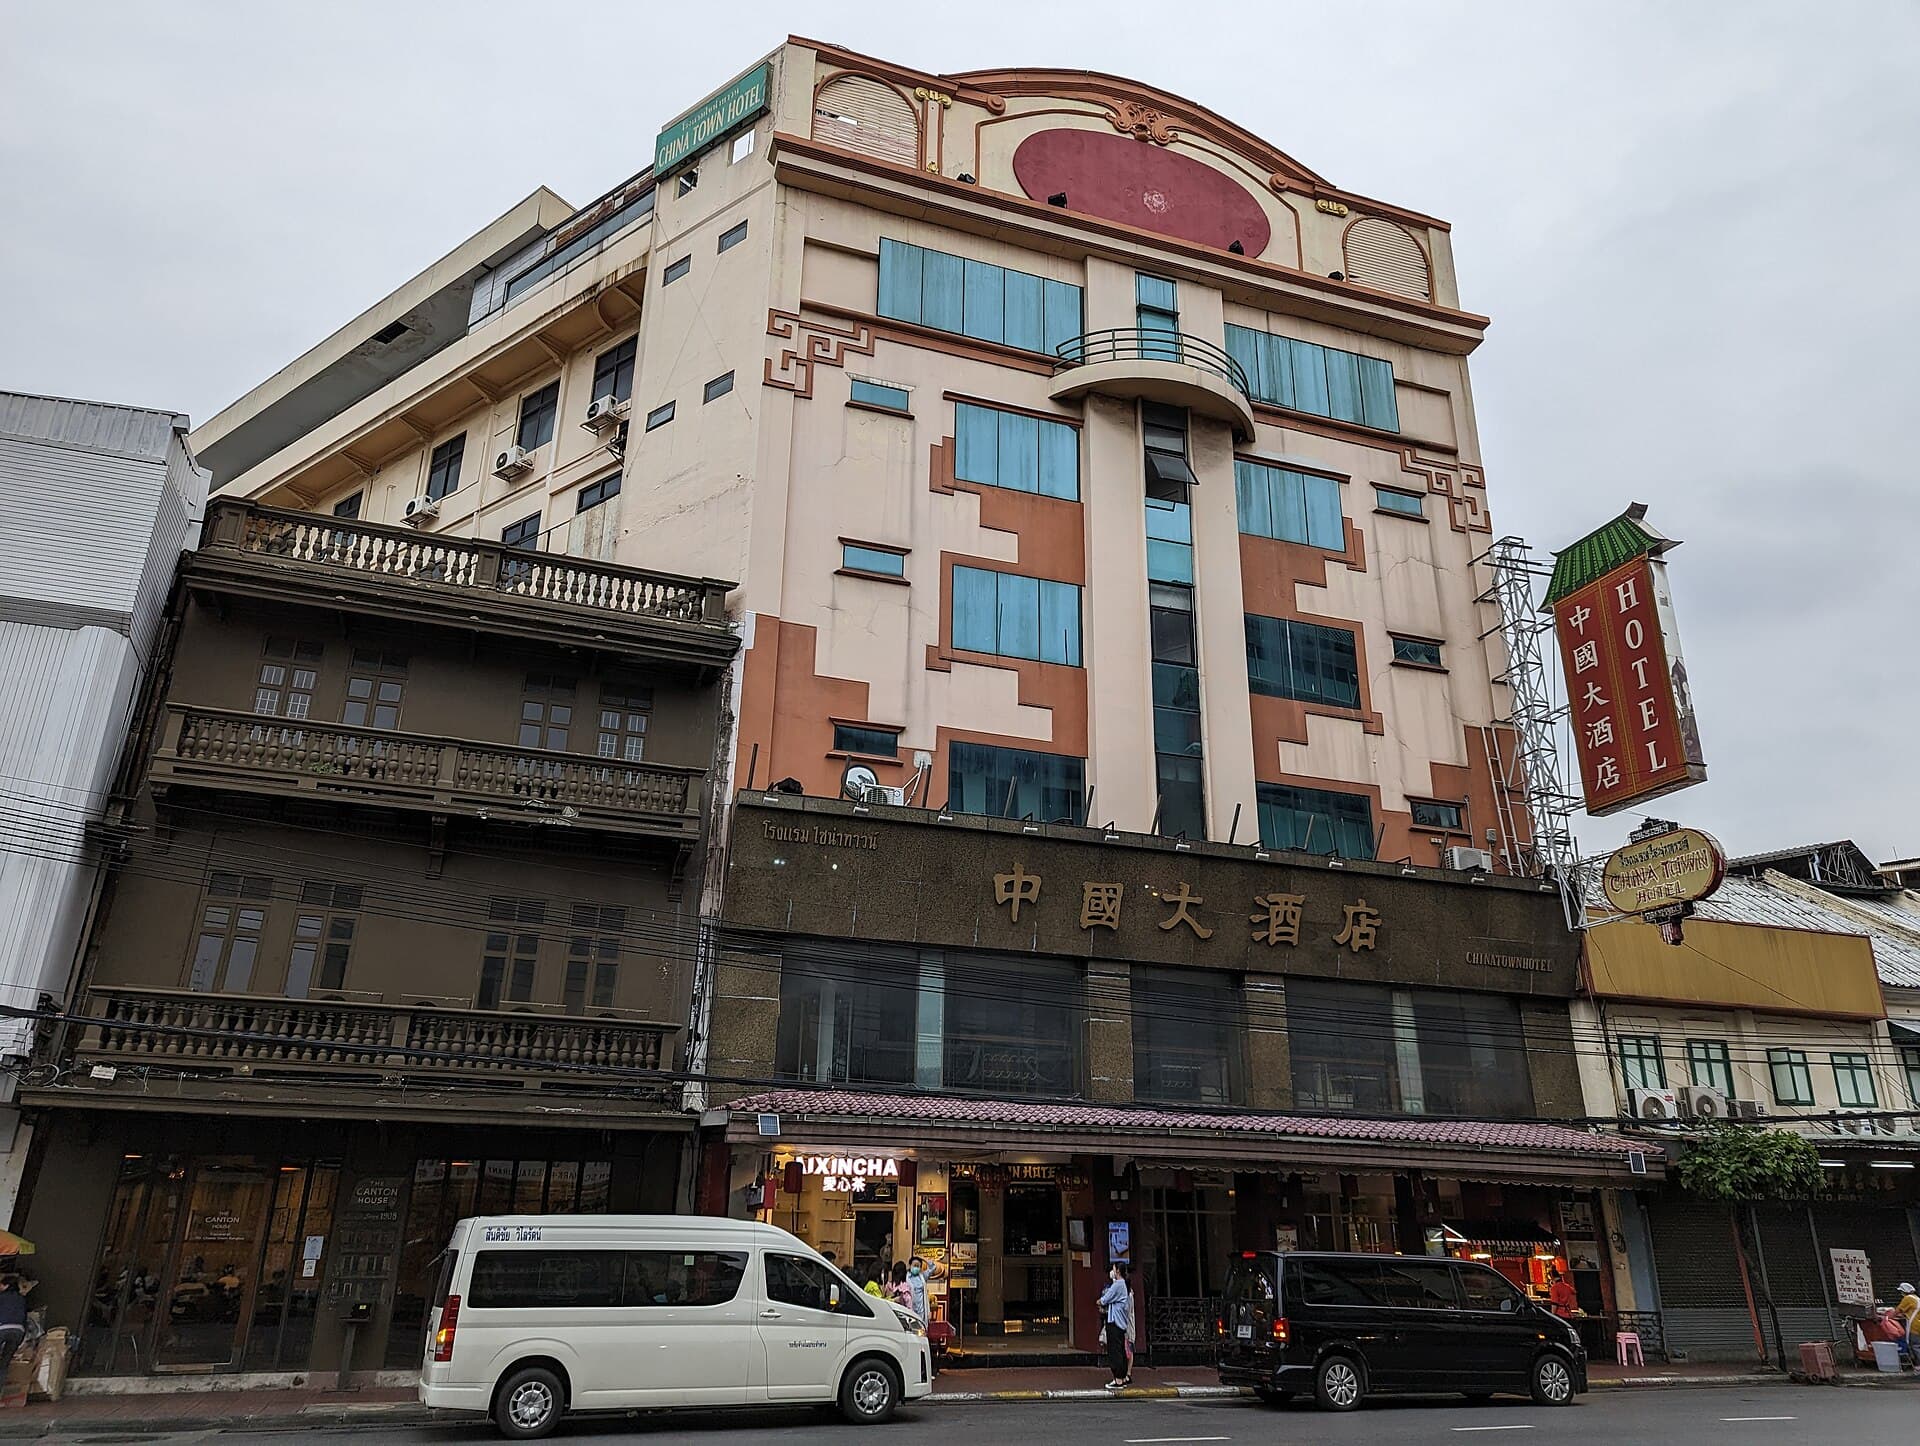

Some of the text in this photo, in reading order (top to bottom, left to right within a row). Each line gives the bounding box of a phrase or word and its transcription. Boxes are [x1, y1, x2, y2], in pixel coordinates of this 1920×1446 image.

[658, 131, 690, 169] CHINA
[692, 107, 725, 146] TOWN
[727, 83, 761, 125] HOTEL
[1614, 577, 1667, 774] HOTEL
[1567, 604, 1621, 792] 中國大酒店
[762, 818, 881, 851] โรงแรม ไชน่าทาวน์
[1609, 847, 1711, 894] CHINA TOWN
[992, 861, 1382, 953] 中國大酒店
[1636, 880, 1687, 904] HOTEL
[356, 1187, 398, 1197] CANTON
[358, 1197, 390, 1205] HOUSE
[205, 1216, 240, 1224] CANTON
